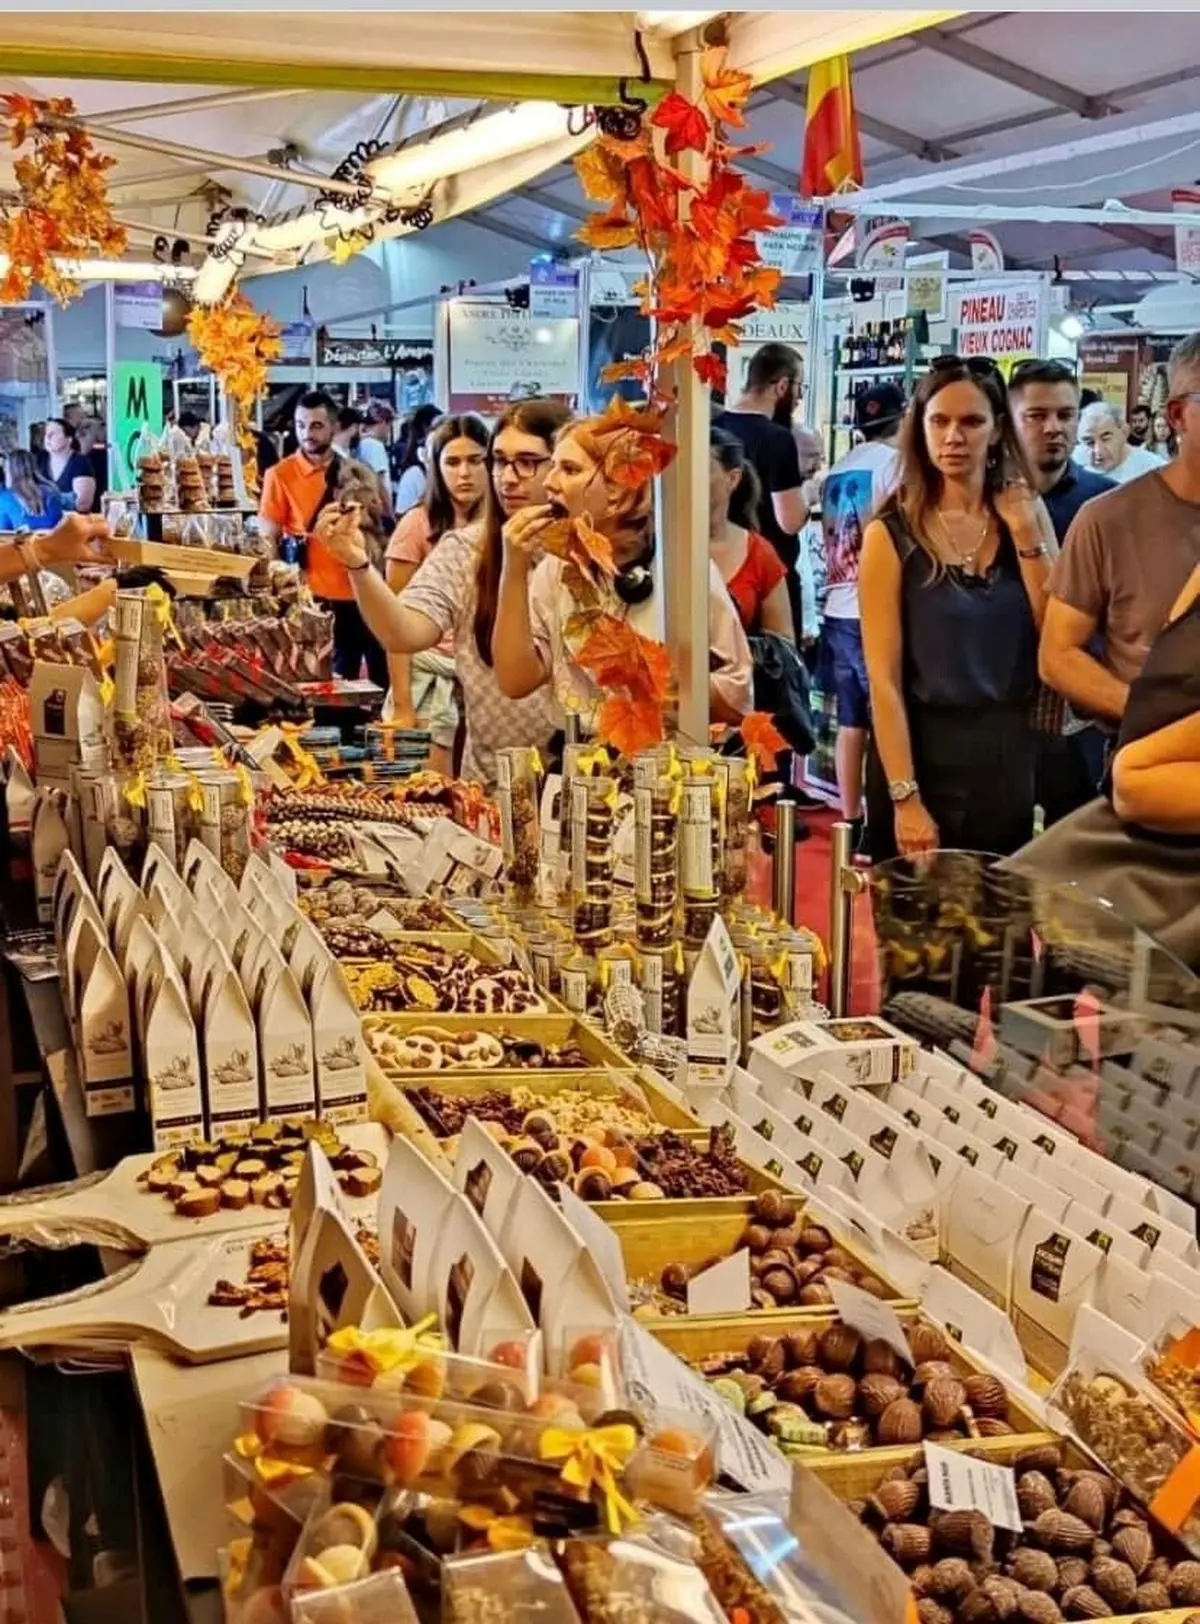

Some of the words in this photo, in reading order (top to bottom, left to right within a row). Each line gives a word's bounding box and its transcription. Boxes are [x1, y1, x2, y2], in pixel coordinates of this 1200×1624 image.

[960, 294, 1006, 325] PINEAU
[960, 331, 988, 353] VIEUX
[991, 325, 1034, 352] COGNAC
